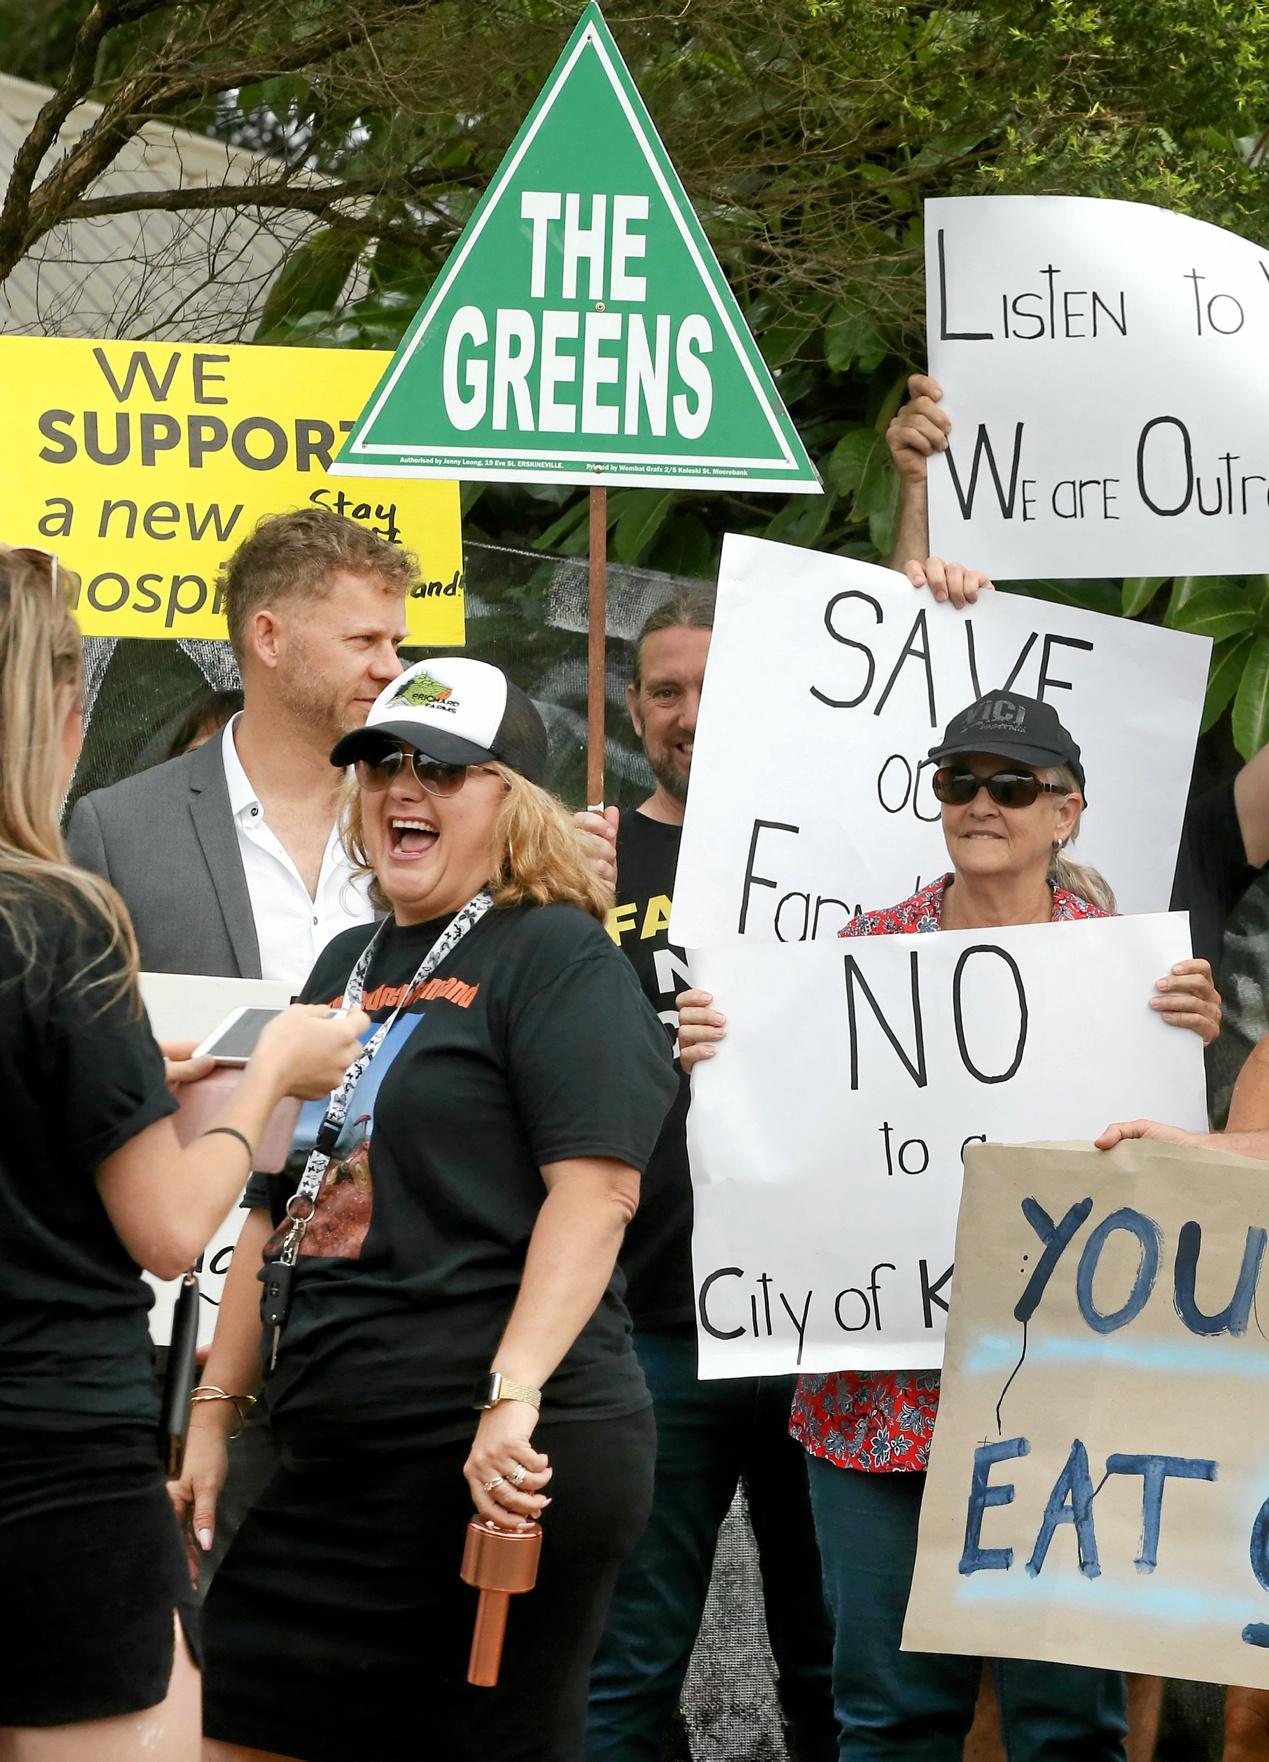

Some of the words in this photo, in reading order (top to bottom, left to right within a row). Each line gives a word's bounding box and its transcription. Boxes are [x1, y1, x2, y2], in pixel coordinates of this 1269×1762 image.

[520, 191, 650, 303] THE
[1183, 268, 1244, 336] to
[93, 347, 230, 404] WE
[443, 306, 714, 440] GREENS
[38, 498, 74, 537] a
[98, 499, 244, 542] new
[309, 489, 397, 531] Stay
[809, 590, 1094, 728] SAVE
[844, 944, 1028, 1090] NO
[878, 1121, 929, 1176] to
[699, 1266, 812, 1365] City
[835, 1263, 896, 1331] of
[1012, 1195, 1268, 1340] YOU
[959, 1435, 1219, 1580] EAT
